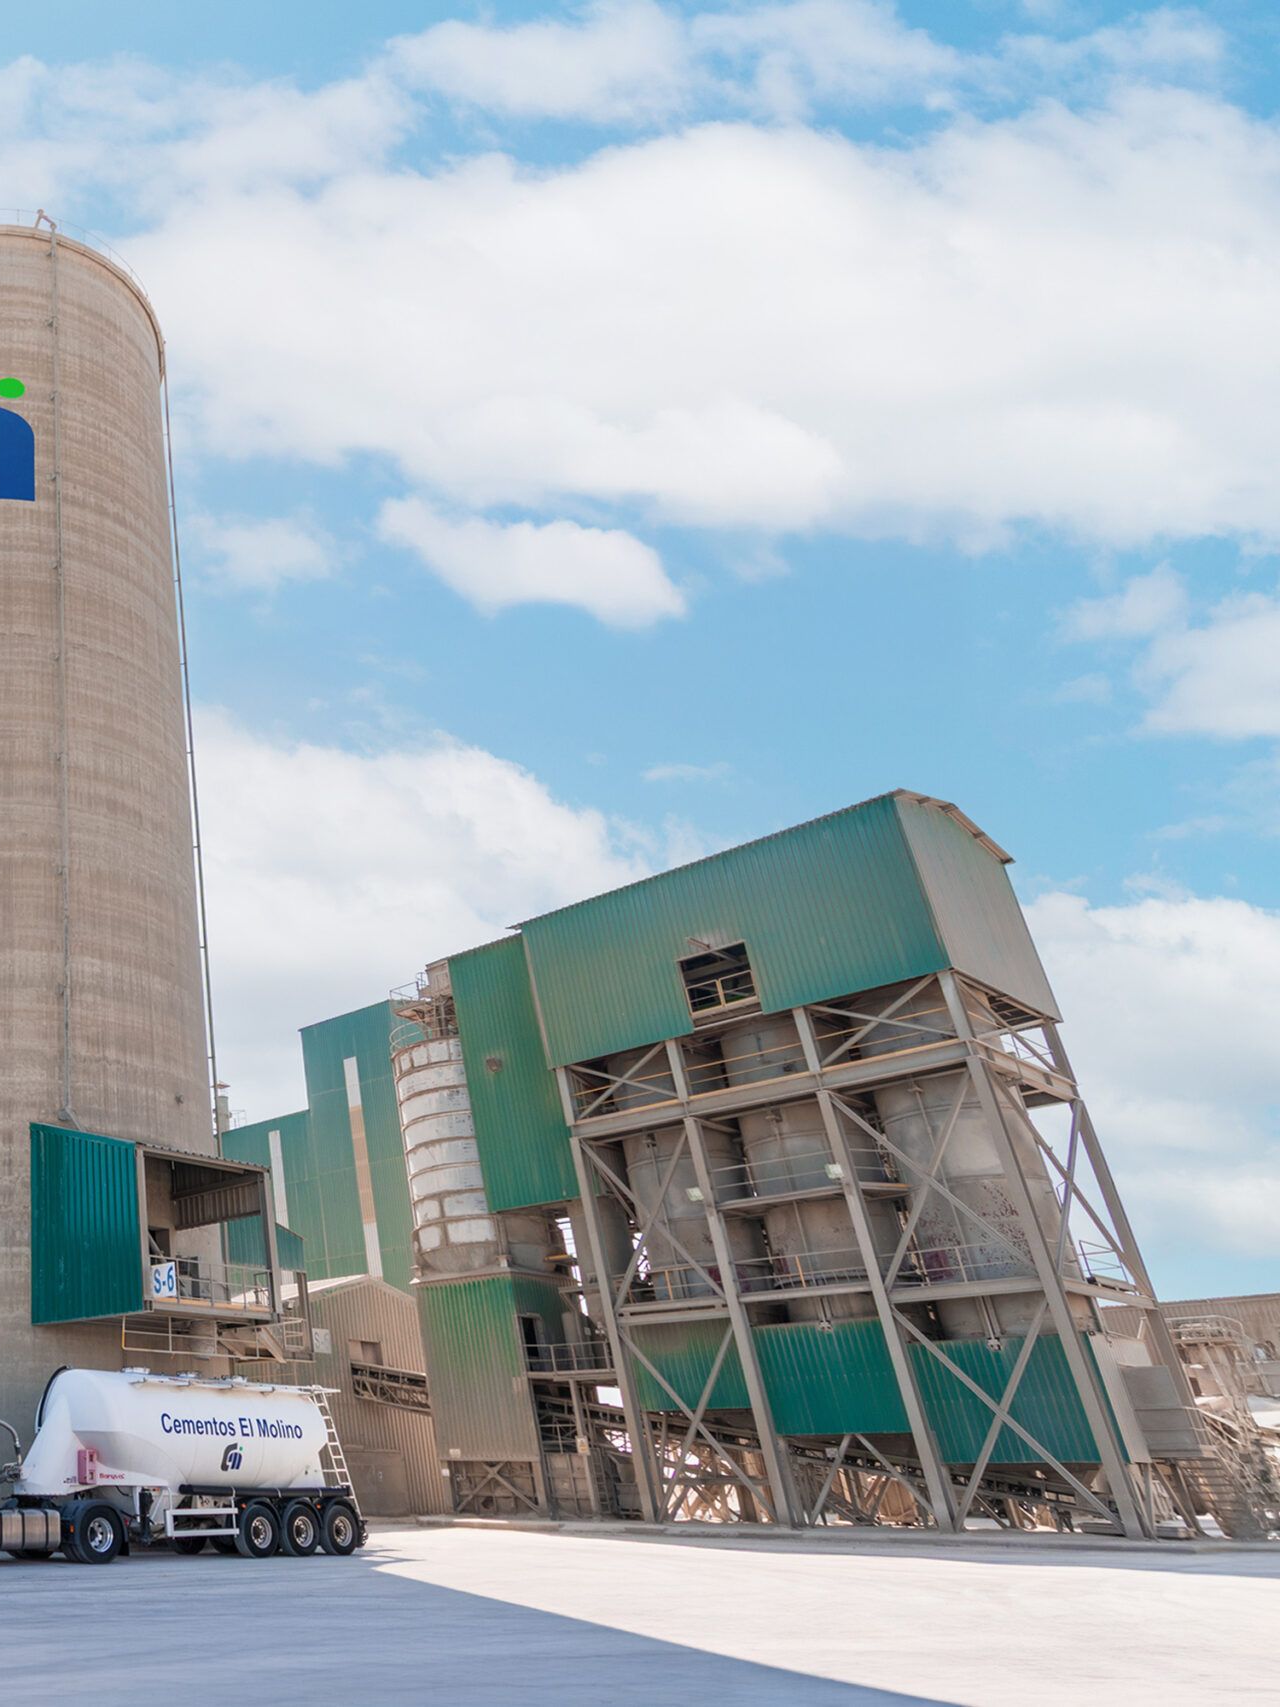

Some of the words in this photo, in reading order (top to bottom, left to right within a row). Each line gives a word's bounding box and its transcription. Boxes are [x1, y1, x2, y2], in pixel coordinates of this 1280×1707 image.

[153, 1265, 174, 1294] S-6
[160, 1412, 236, 1437] Cementos
[238, 1417, 254, 1437] El
[257, 1418, 303, 1439] Molino
